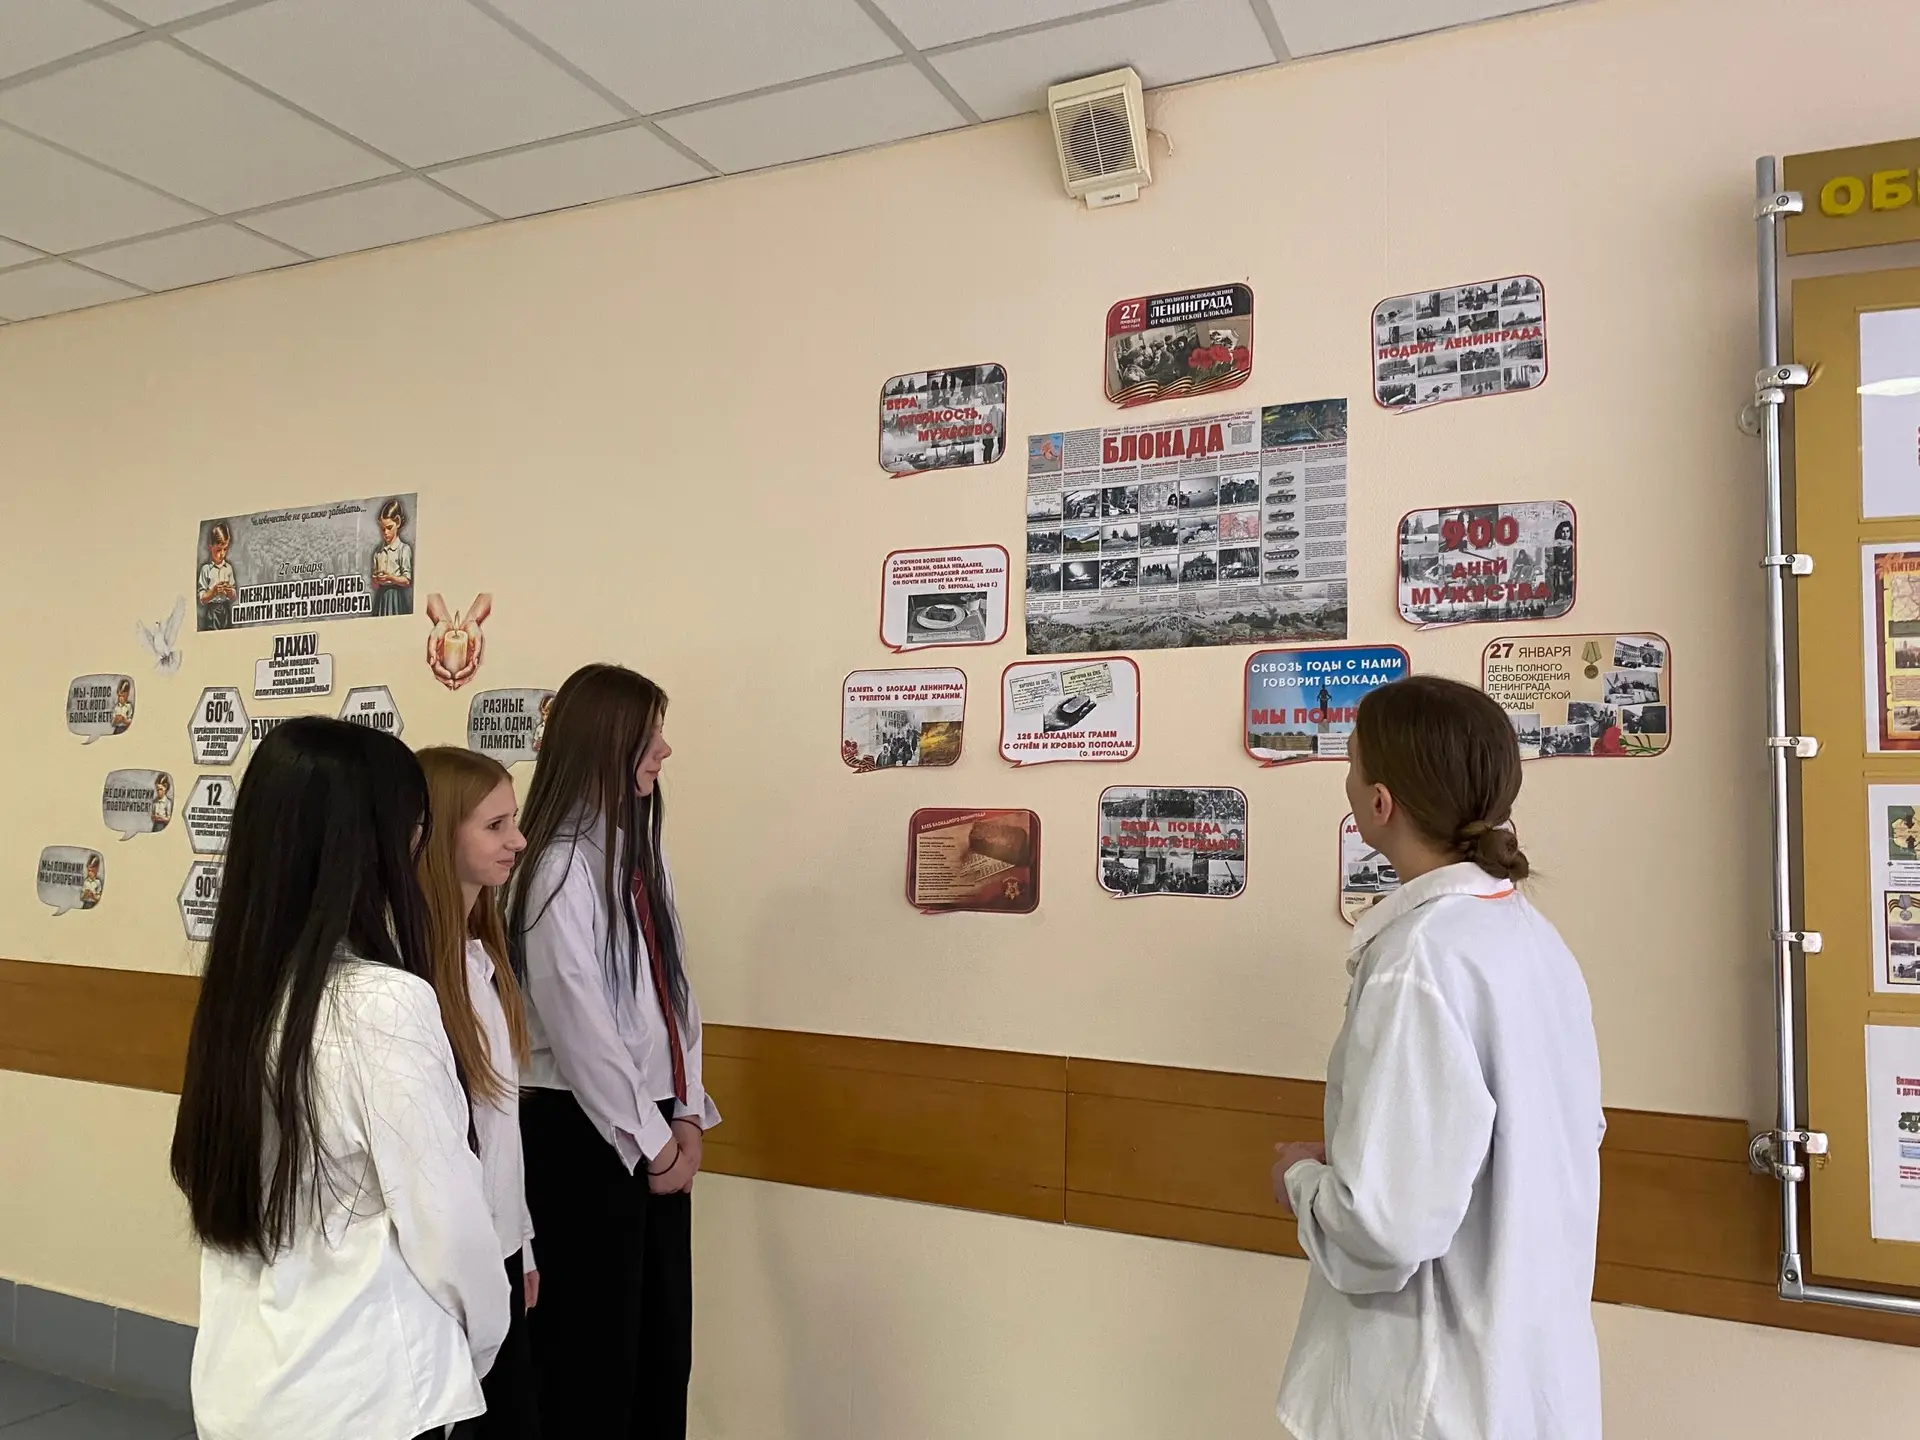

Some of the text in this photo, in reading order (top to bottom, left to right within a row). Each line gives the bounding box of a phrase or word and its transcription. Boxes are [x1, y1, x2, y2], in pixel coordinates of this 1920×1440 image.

[1821, 168, 1920, 216] ОБ
[1120, 304, 1140, 319] 27
[1151, 296, 1232, 318] ЛЕНИНГРАДА
[1204, 308, 1233, 318] БЛОКАДЫ
[1379, 326, 1544, 359] ПОДВИГ ЛЕНИНГРАДА
[886, 396, 921, 411] ВЕРА,
[898, 407, 982, 428] СТОЙКОСТЬ,
[918, 422, 994, 442] МУЖЕСТВО
[1103, 424, 1224, 464] БЛОКАДА
[1441, 516, 1519, 549] 900
[279, 561, 323, 575] 27 января
[1452, 557, 1508, 580] ДНЕЙ
[240, 577, 364, 603] МЕЖДУНАРОДНЫЙ ДЕНЬ
[1412, 582, 1553, 606] МУЖЕСТВА
[233, 595, 370, 622] ПАМЯТИ ЖЕРТВ ХОЛОКОСТА
[274, 634, 316, 660] ДАХАУ
[1489, 643, 1571, 658] 27 ЯНВАРЯ
[1251, 658, 1402, 673] СКВОЗЬ ГОДЫ С НАМИ
[1488, 663, 1562, 673] ДЕНЬ ПОЛНОГО
[1263, 676, 1320, 688] ГОВОРИТ
[1488, 672, 1570, 682] ОСВОБОЖДЕНИЯ
[90, 686, 112, 698] ГОЛОС
[1488, 683, 1550, 692] ЛЕНИНГРАДА
[1489, 690, 1571, 700] ОТ ФАШИСТСКОЙ
[90, 699, 106, 710] КОГО
[206, 700, 234, 723] 60%
[483, 698, 524, 713] РАЗНЫЕ
[69, 712, 97, 723] БОЛЬШЕ
[473, 716, 532, 732] ВЕРЫ, ОДНА
[1251, 709, 1286, 725] МЫ
[480, 735, 525, 749] ПАМЯТЬ!
[1034, 732, 1085, 740] БЛОКАДНЫХ
[1088, 730, 1117, 738] ГРАММ
[1013, 741, 1039, 750] ОГНЁМ
[1089, 740, 1135, 749] ПОПОЛАМ.
[1092, 750, 1128, 758] БЕРГОЛЬЦ)
[207, 783, 222, 806] 12
[1168, 821, 1221, 834] ПОБЕДА
